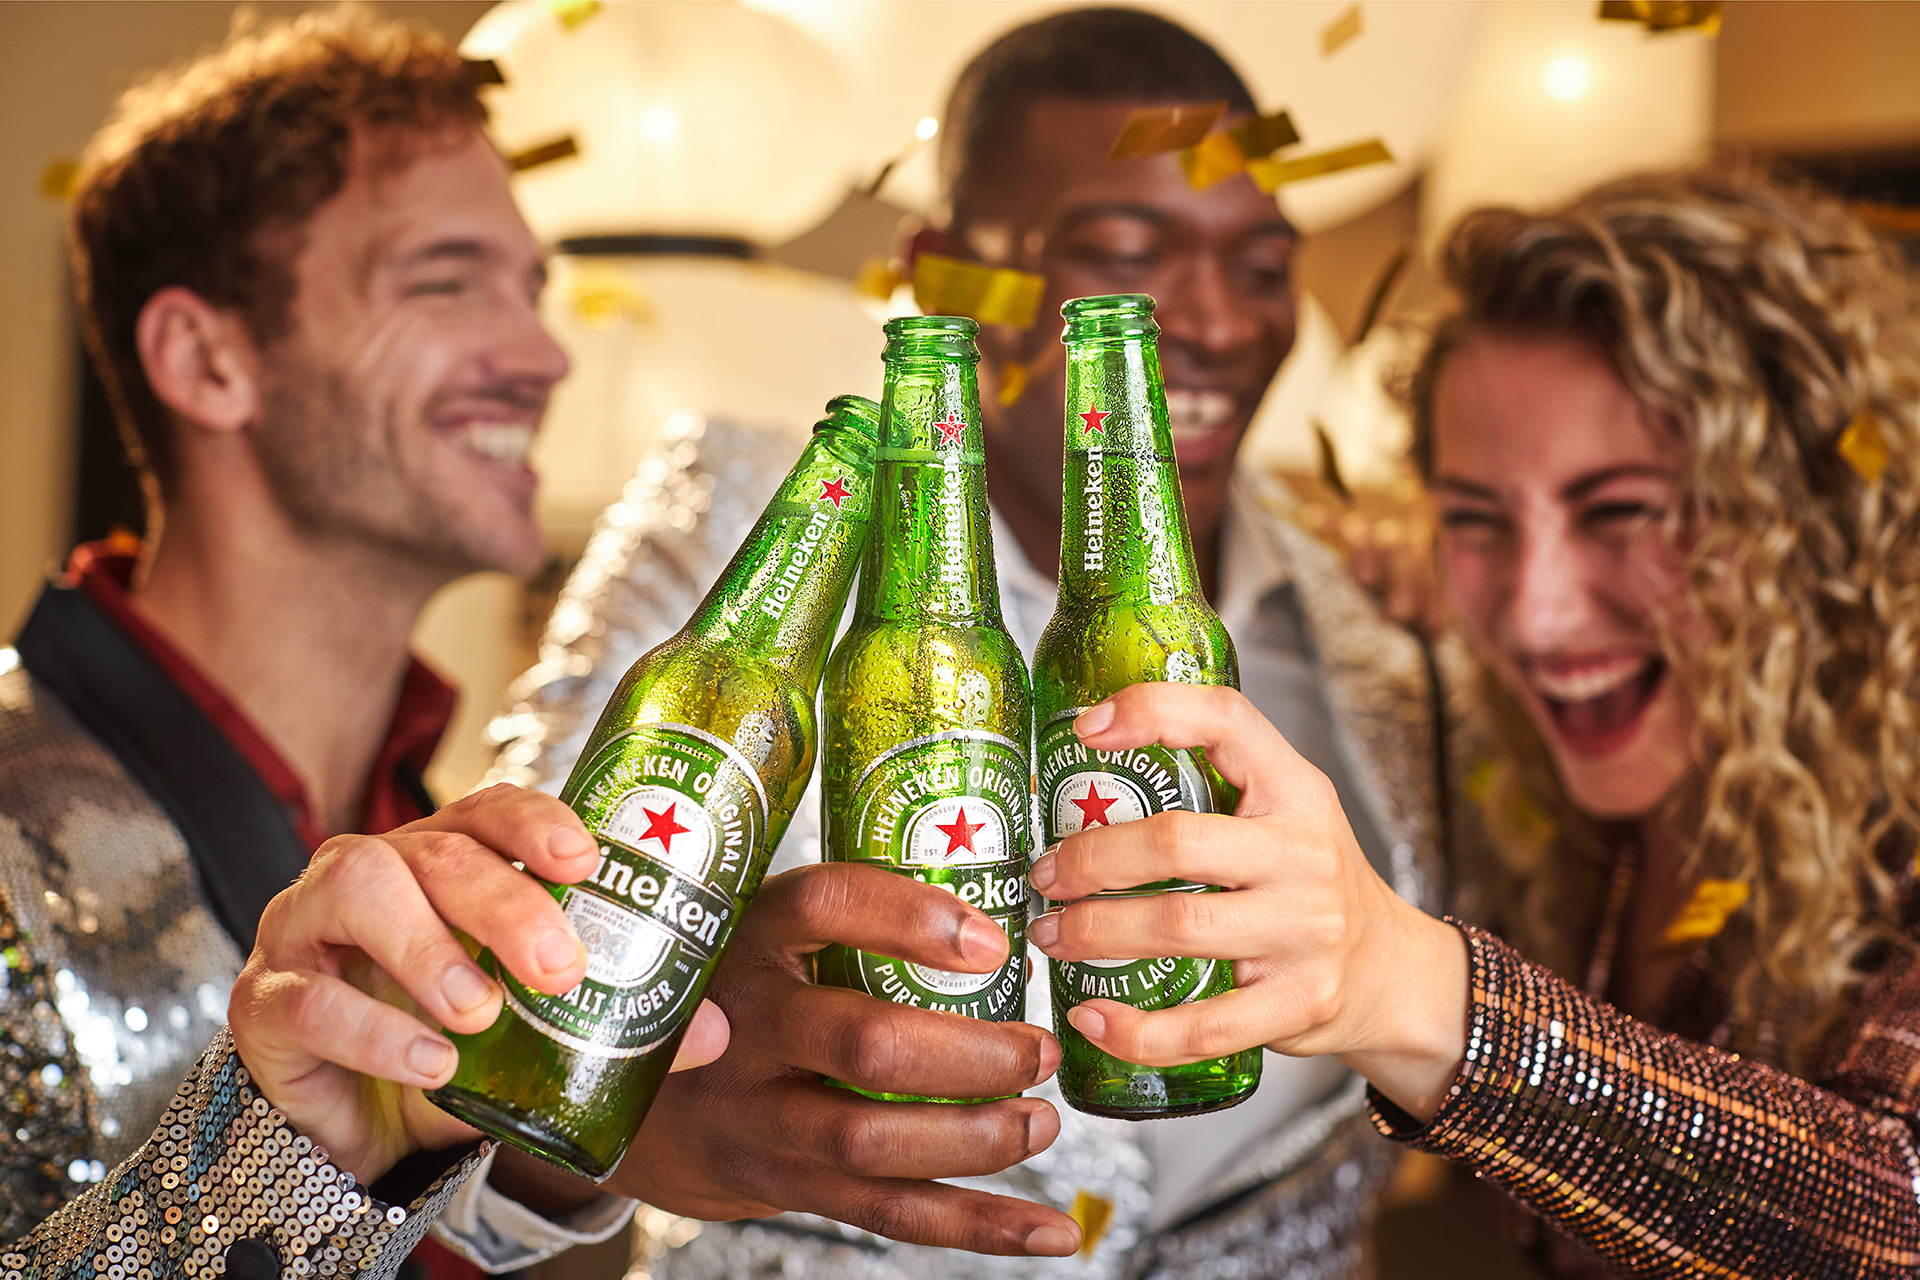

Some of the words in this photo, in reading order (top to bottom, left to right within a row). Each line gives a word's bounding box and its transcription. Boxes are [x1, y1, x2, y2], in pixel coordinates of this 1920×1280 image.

[939, 458, 962, 583] Heineken
[1084, 445, 1104, 571] Heineken
[760, 509, 831, 620] Heineken
[873, 766, 960, 844] HEINEKEN
[969, 766, 1025, 839] ORIGINAL
[1040, 743, 1088, 818] HEINEKEN
[1096, 749, 1183, 812] ORIGINAL
[1098, 780, 1135, 801] AMSTERDAM
[583, 755, 690, 811] HEINEKEN
[693, 772, 743, 873] ORIGINAL
[619, 825, 635, 837] EST.
[912, 829, 922, 860] DIPLOME
[920, 804, 956, 827] D'HONNEUR
[924, 848, 941, 856] EST.
[588, 846, 720, 947] ineken
[558, 984, 607, 1015] ALT
[613, 979, 675, 1020] LAGER
[874, 962, 922, 1009] PURE
[987, 955, 1021, 1015] LAGER
[916, 964, 936, 983] COURS
[938, 979, 967, 988] MEMBRE
[1055, 958, 1077, 985] RE
[1081, 973, 1130, 997] MALT
[1137, 956, 1183, 990] LAG
[1068, 995, 1082, 1005] REC
[1133, 995, 1161, 1009] NEKEN
